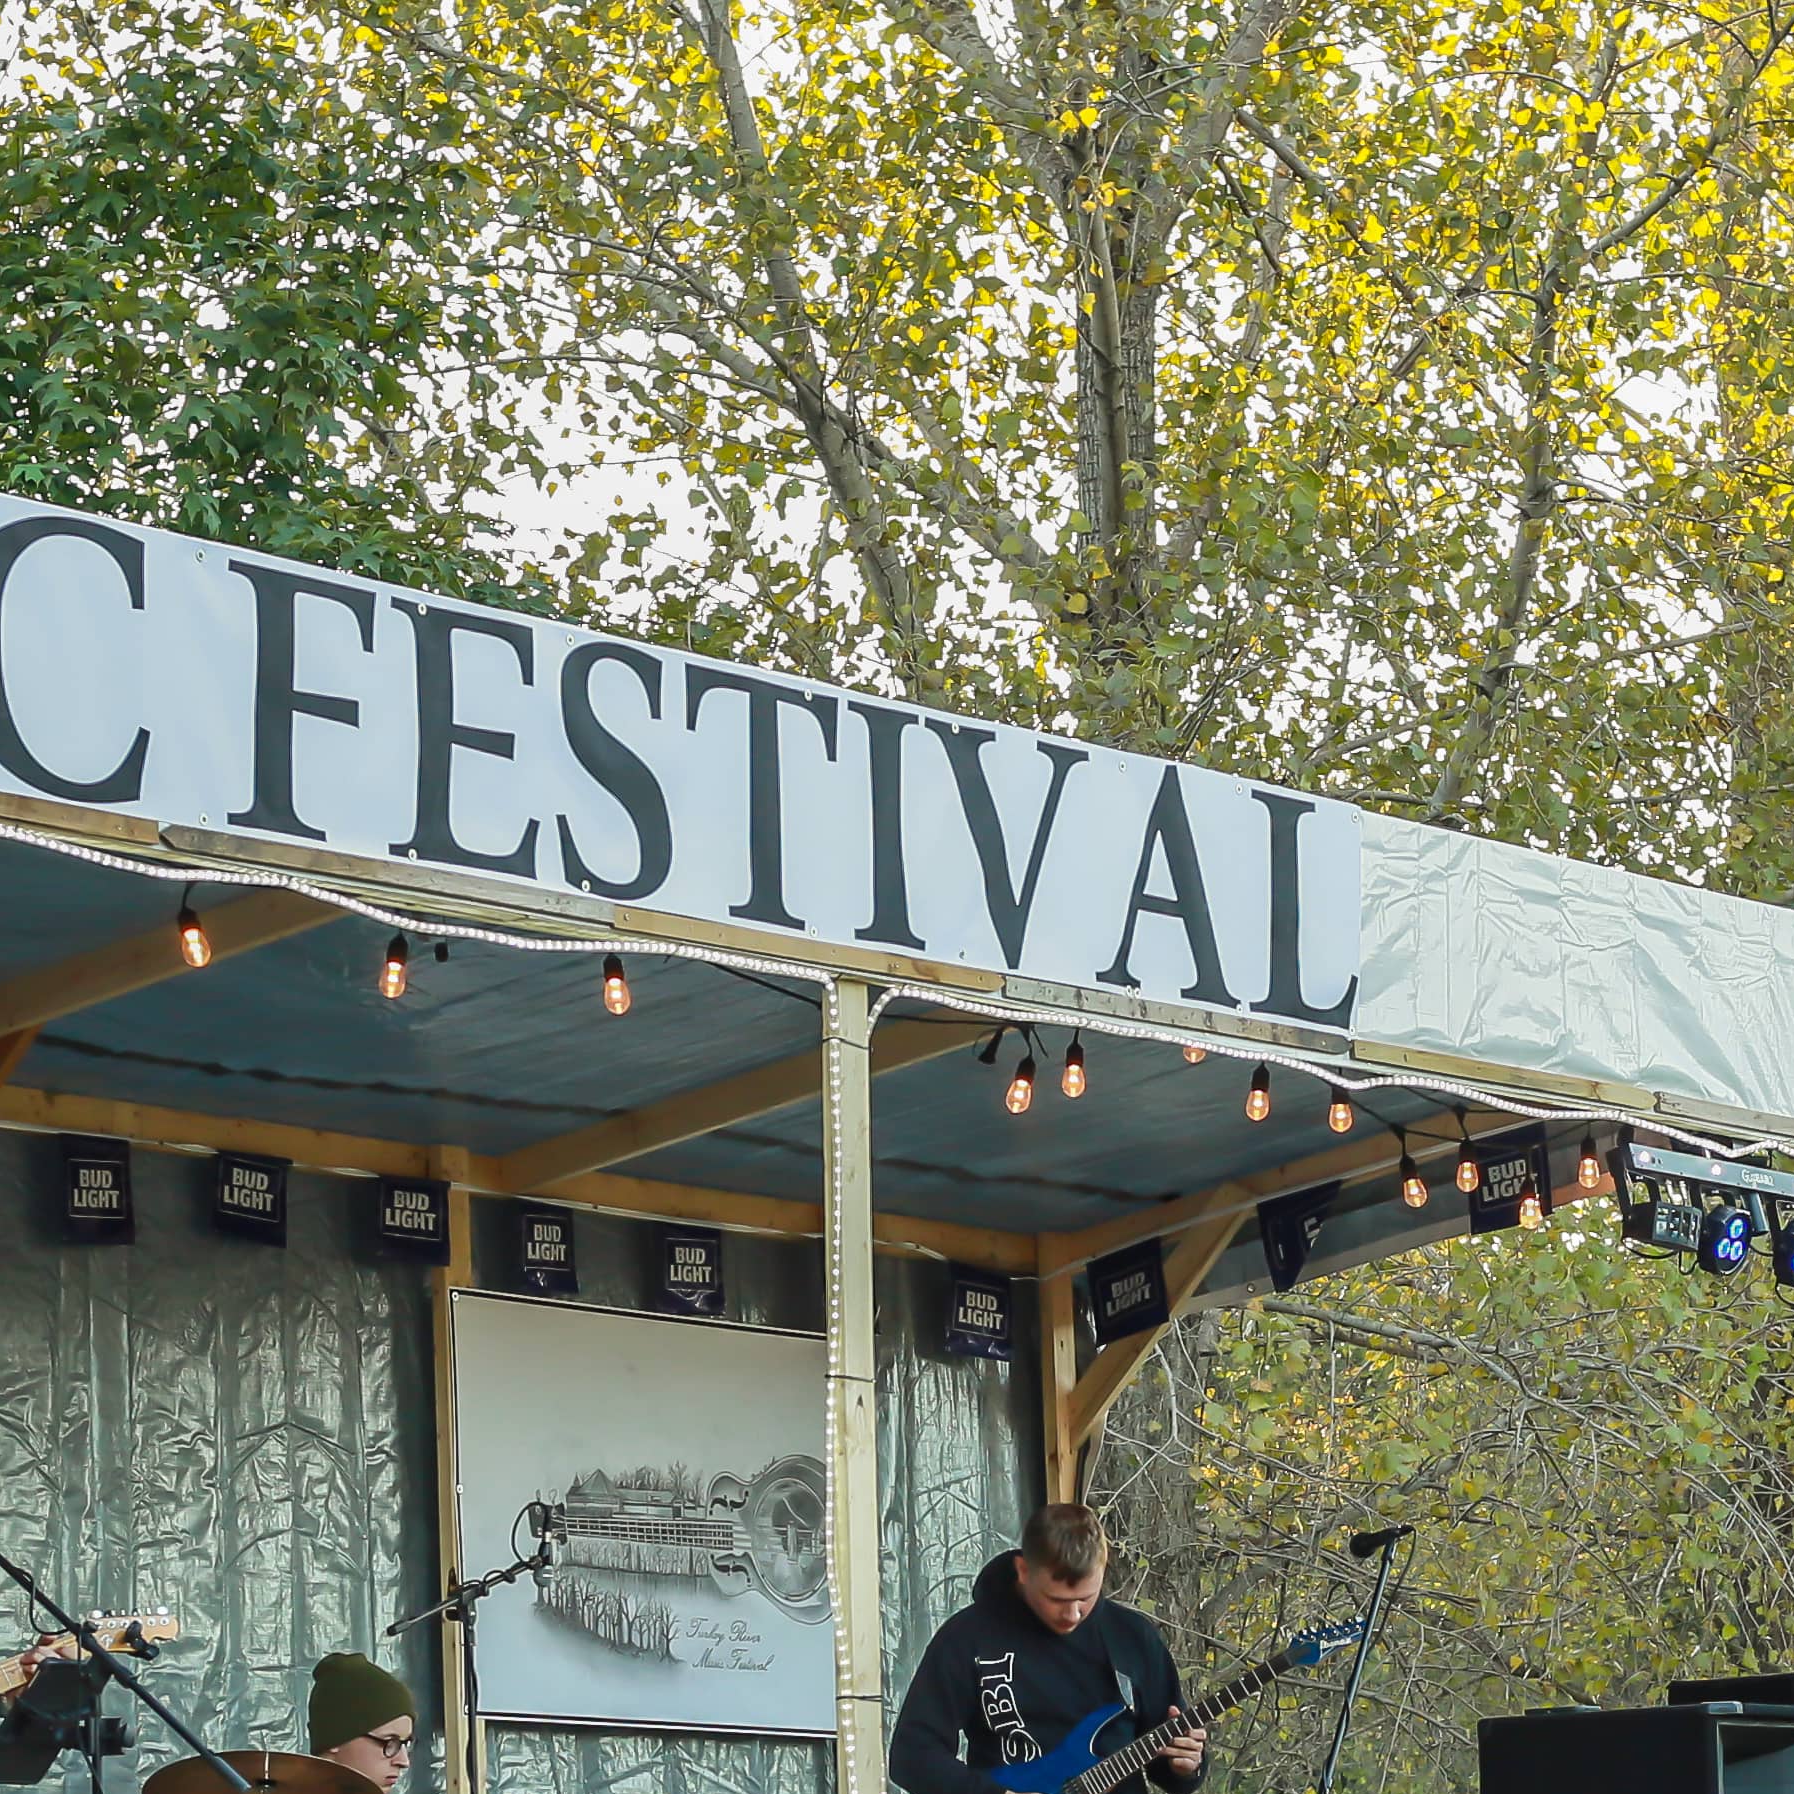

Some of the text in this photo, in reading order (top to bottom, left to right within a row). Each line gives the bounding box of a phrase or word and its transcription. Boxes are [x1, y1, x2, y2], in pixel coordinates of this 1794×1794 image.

[226, 559, 1358, 1030] FESTIVAL
[78, 1169, 112, 1189] BUD
[232, 1168, 269, 1191] BUD
[1488, 1159, 1527, 1184] BUD
[73, 1187, 119, 1209] LIGHT
[224, 1186, 273, 1211] LIGHT
[393, 1190, 429, 1212] BUD
[384, 1206, 436, 1231] LIGHT
[532, 1224, 562, 1244] BUD
[527, 1241, 567, 1263] LIGHT
[675, 1245, 705, 1266] BUD
[670, 1263, 711, 1284] LIGHT
[1111, 1272, 1148, 1295] BUD
[966, 1290, 998, 1312] BUD
[1106, 1283, 1156, 1312] LIGHT
[958, 1307, 1004, 1329] LIGHT
